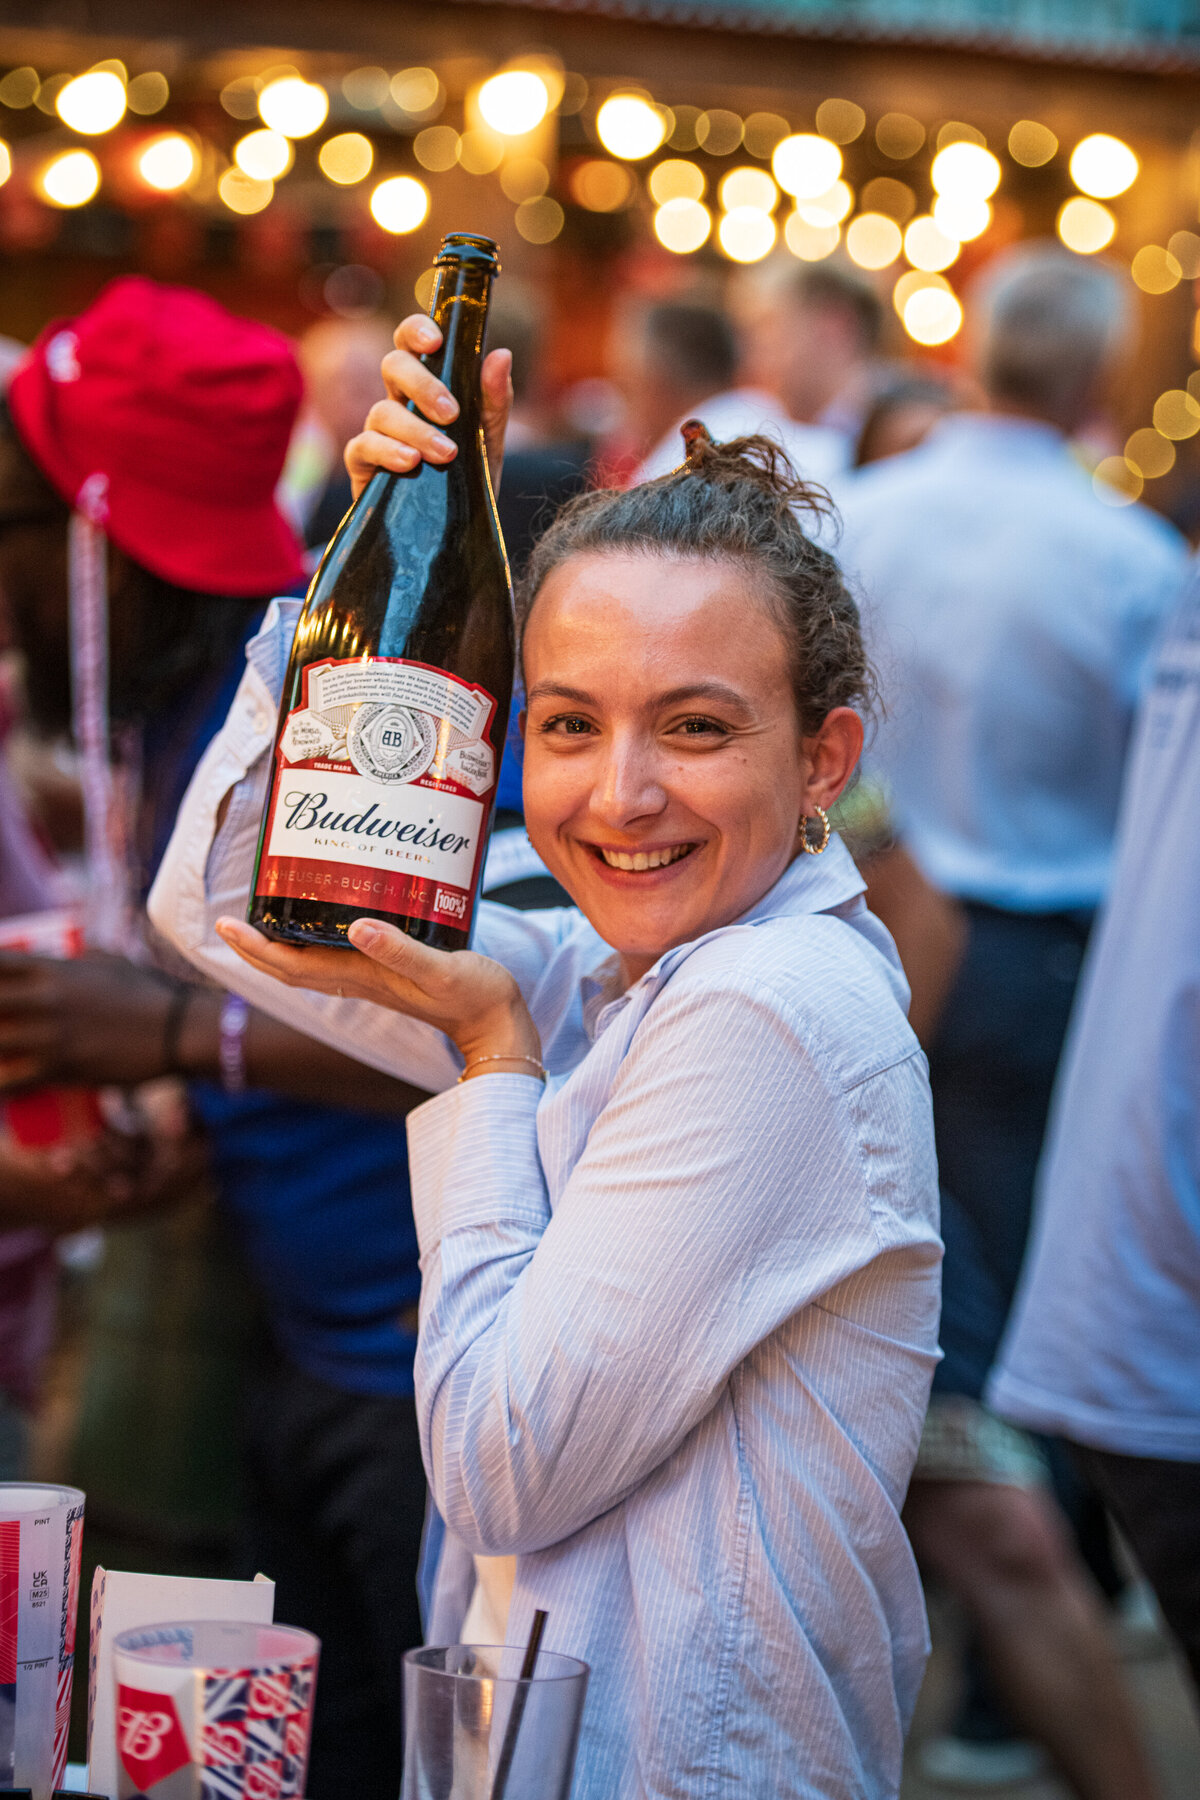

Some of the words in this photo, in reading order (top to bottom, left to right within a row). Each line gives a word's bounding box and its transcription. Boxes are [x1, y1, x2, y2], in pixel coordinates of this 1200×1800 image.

[416, 677, 431, 685] know
[323, 687, 345, 697] exclusive
[397, 687, 423, 696] produces
[436, 690, 447, 699] brew
[419, 699, 433, 707] other
[382, 730, 402, 748] AB
[313, 762, 333, 770] TRADE
[333, 764, 352, 773] MARK
[420, 779, 457, 793] REGISTERED
[284, 791, 471, 854] Budweiser
[314, 837, 351, 849] KING
[357, 844, 378, 852] OF
[400, 888, 431, 904] INC.
[34, 1517, 50, 1526] PINT
[32, 1570, 48, 1579] UK
[32, 1579, 48, 1587] CA
[31, 1589, 48, 1599] M25
[34, 1661, 49, 1670] PINT
